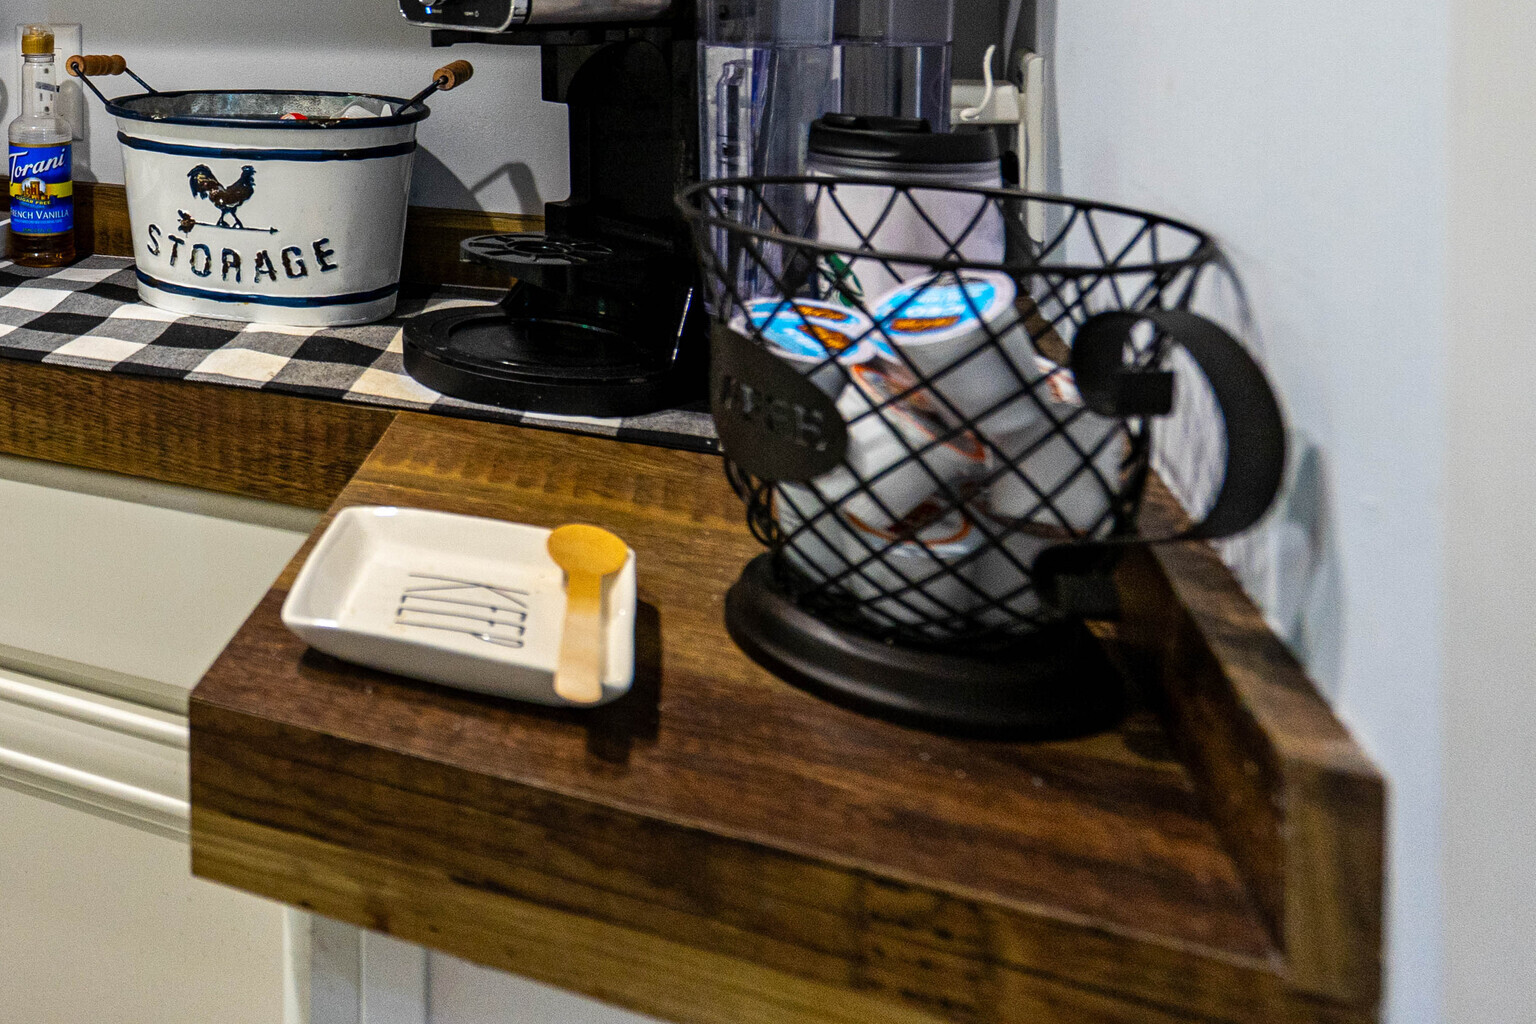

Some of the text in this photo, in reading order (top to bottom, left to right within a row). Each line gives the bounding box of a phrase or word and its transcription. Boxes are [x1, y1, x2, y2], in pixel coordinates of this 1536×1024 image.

[9, 147, 66, 188] Torani
[35, 208, 70, 220] VANILLA
[146, 222, 339, 284] STORAGE
